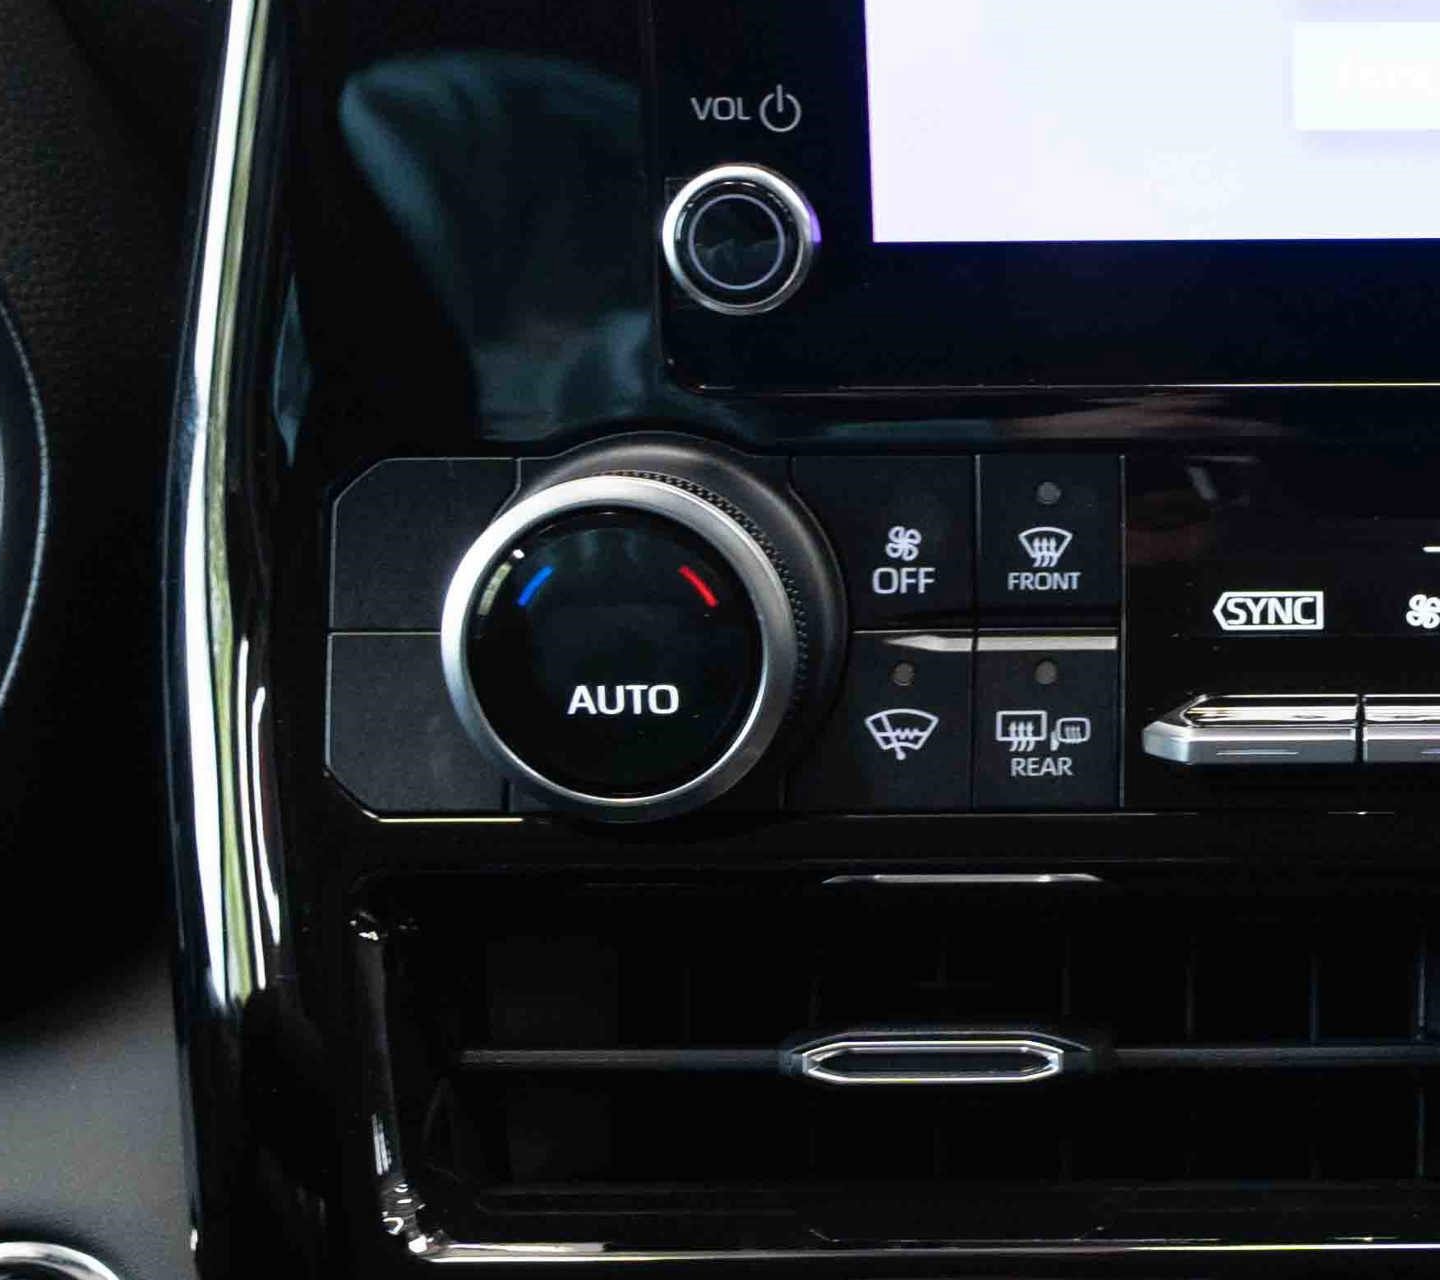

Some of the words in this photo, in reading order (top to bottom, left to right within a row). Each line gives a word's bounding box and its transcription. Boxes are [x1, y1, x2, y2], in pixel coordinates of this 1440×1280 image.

[690, 97, 751, 120] VOL
[872, 568, 936, 595] OFF
[1007, 570, 1080, 592] FRONT
[1226, 596, 1316, 627] SYNC
[568, 684, 680, 716] AUTO
[1010, 757, 1072, 777] REAR
